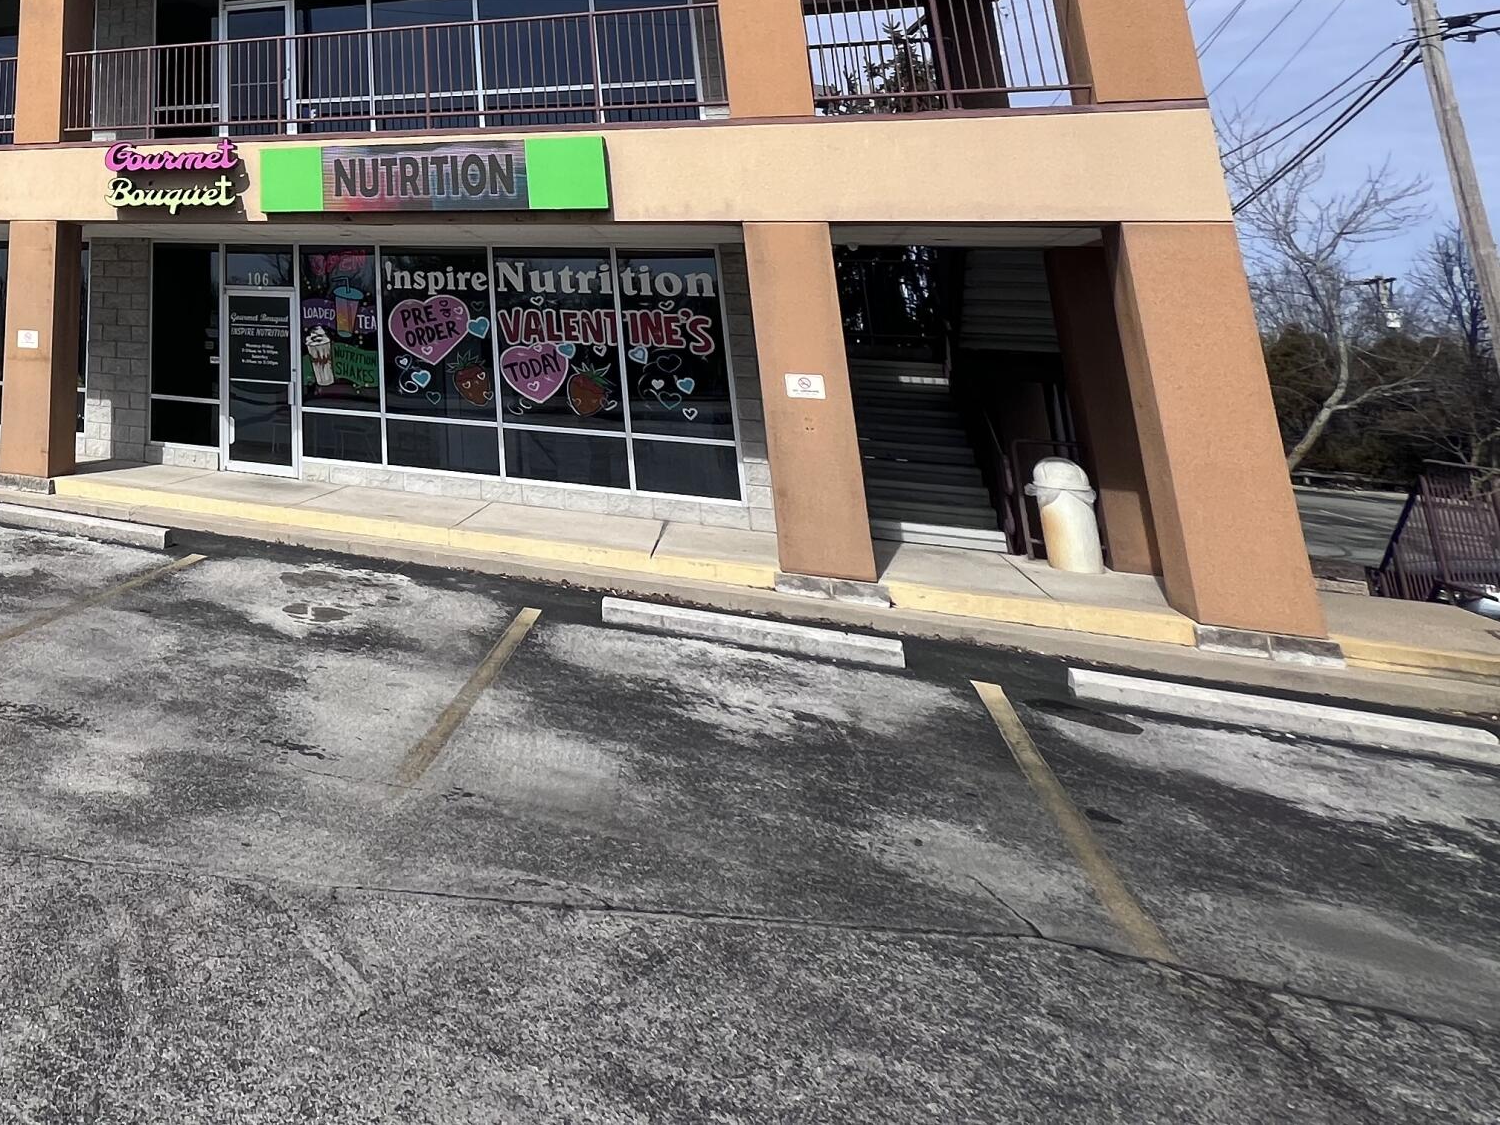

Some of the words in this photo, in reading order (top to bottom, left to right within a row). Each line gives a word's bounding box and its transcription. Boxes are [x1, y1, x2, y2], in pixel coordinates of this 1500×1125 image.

[104, 138, 239, 172] Gourmet
[333, 153, 516, 198] NUTRITION
[104, 175, 236, 215] Bouquet
[247, 272, 269, 286] 106
[495, 262, 716, 297] Nutrition
[303, 306, 336, 321] LOADED
[357, 314, 378, 330] TEA
[401, 305, 437, 328] PRE
[497, 307, 715, 355] VALENTINE'S
[404, 320, 460, 347] ORDER
[334, 346, 376, 367] NUTRITION
[503, 349, 562, 382] TODAY
[335, 361, 375, 384] SHAKES
